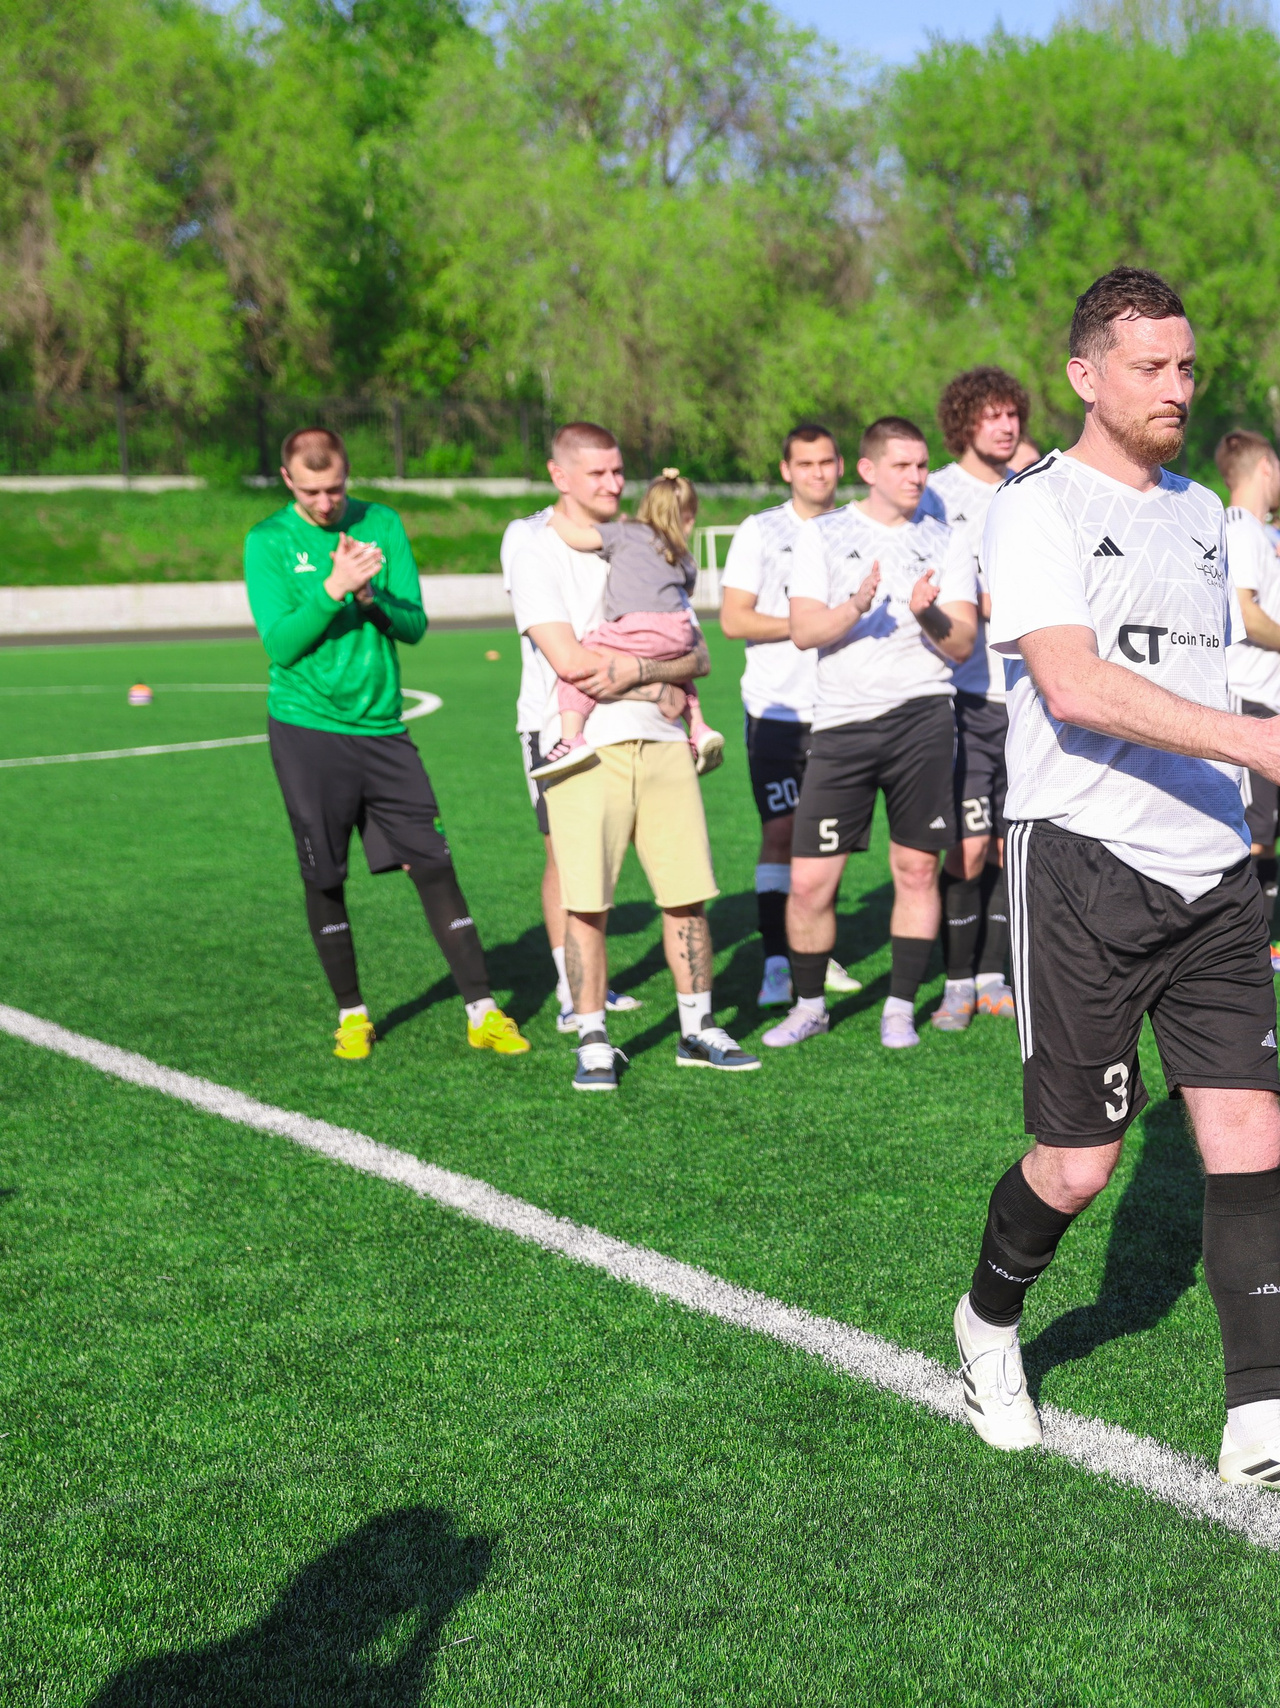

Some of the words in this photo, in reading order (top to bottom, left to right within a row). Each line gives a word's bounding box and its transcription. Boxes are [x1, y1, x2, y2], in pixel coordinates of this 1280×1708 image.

[1118, 624, 1168, 665] CT
[1170, 632, 1197, 646] Coin
[1199, 633, 1220, 648] Tab
[764, 777, 800, 813] 20
[1103, 1062, 1129, 1122] 3
